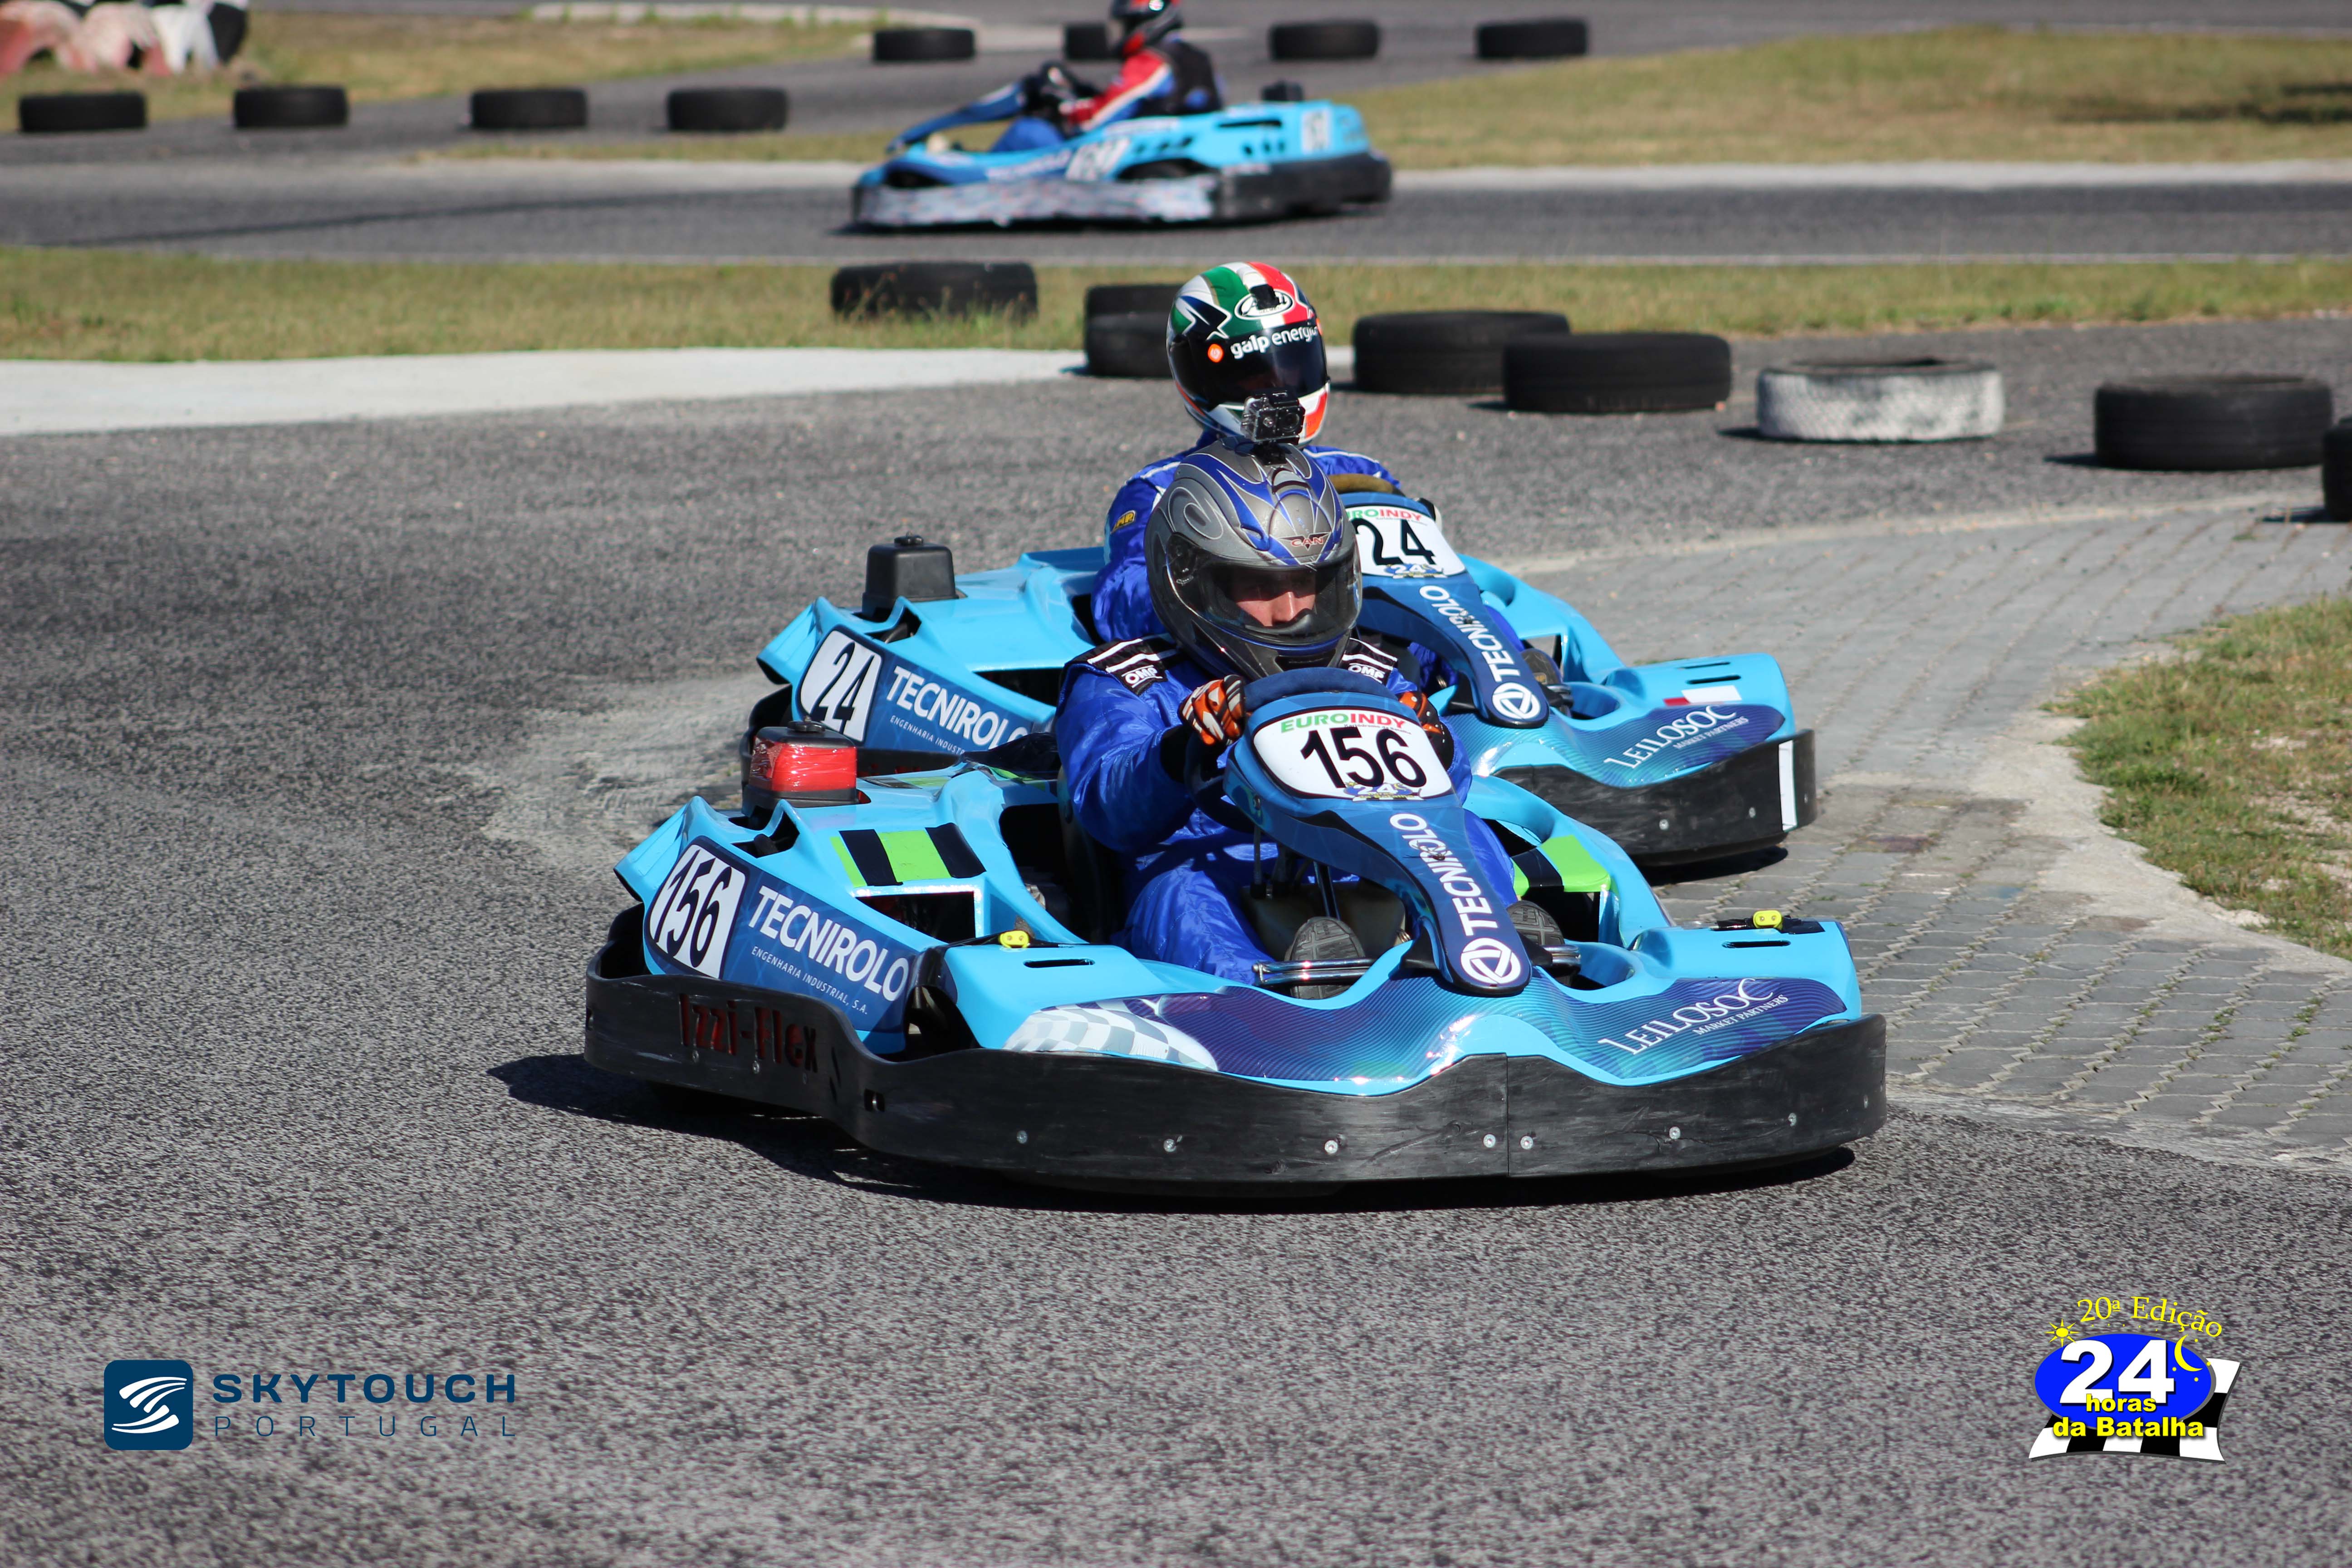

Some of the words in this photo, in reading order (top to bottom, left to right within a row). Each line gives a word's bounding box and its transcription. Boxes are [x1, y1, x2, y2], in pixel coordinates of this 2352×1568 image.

[1230, 334, 1269, 359] galp
[1347, 509, 1422, 521] ROINDY
[1350, 518, 1437, 565] 24
[1420, 585, 1520, 682] TECNIROLO
[808, 642, 875, 734] 24
[1125, 667, 1158, 684] OMP
[1348, 664, 1386, 679] OMP
[890, 715, 934, 742] ENGENHARIA
[1281, 713, 1406, 733] EUROINDY
[1604, 706, 1737, 769] LEILOSOC
[1673, 734, 1706, 750] MARKET
[1705, 715, 1749, 737] PARTNERS
[1301, 727, 1426, 788] 156
[1353, 784, 1398, 794] 24
[1389, 813, 1498, 936] TECNIROLO
[654, 849, 732, 967] 156
[748, 885, 909, 1001] TECNIROLO
[751, 946, 801, 978] ENGENHARIA
[802, 972, 850, 1006] INDUSTRIAL,
[851, 999, 868, 1014] S.A.
[1597, 977, 1773, 1055] LEILOSOC
[1692, 1016, 1737, 1035] MARKET
[1735, 994, 1789, 1020] PARTNERS
